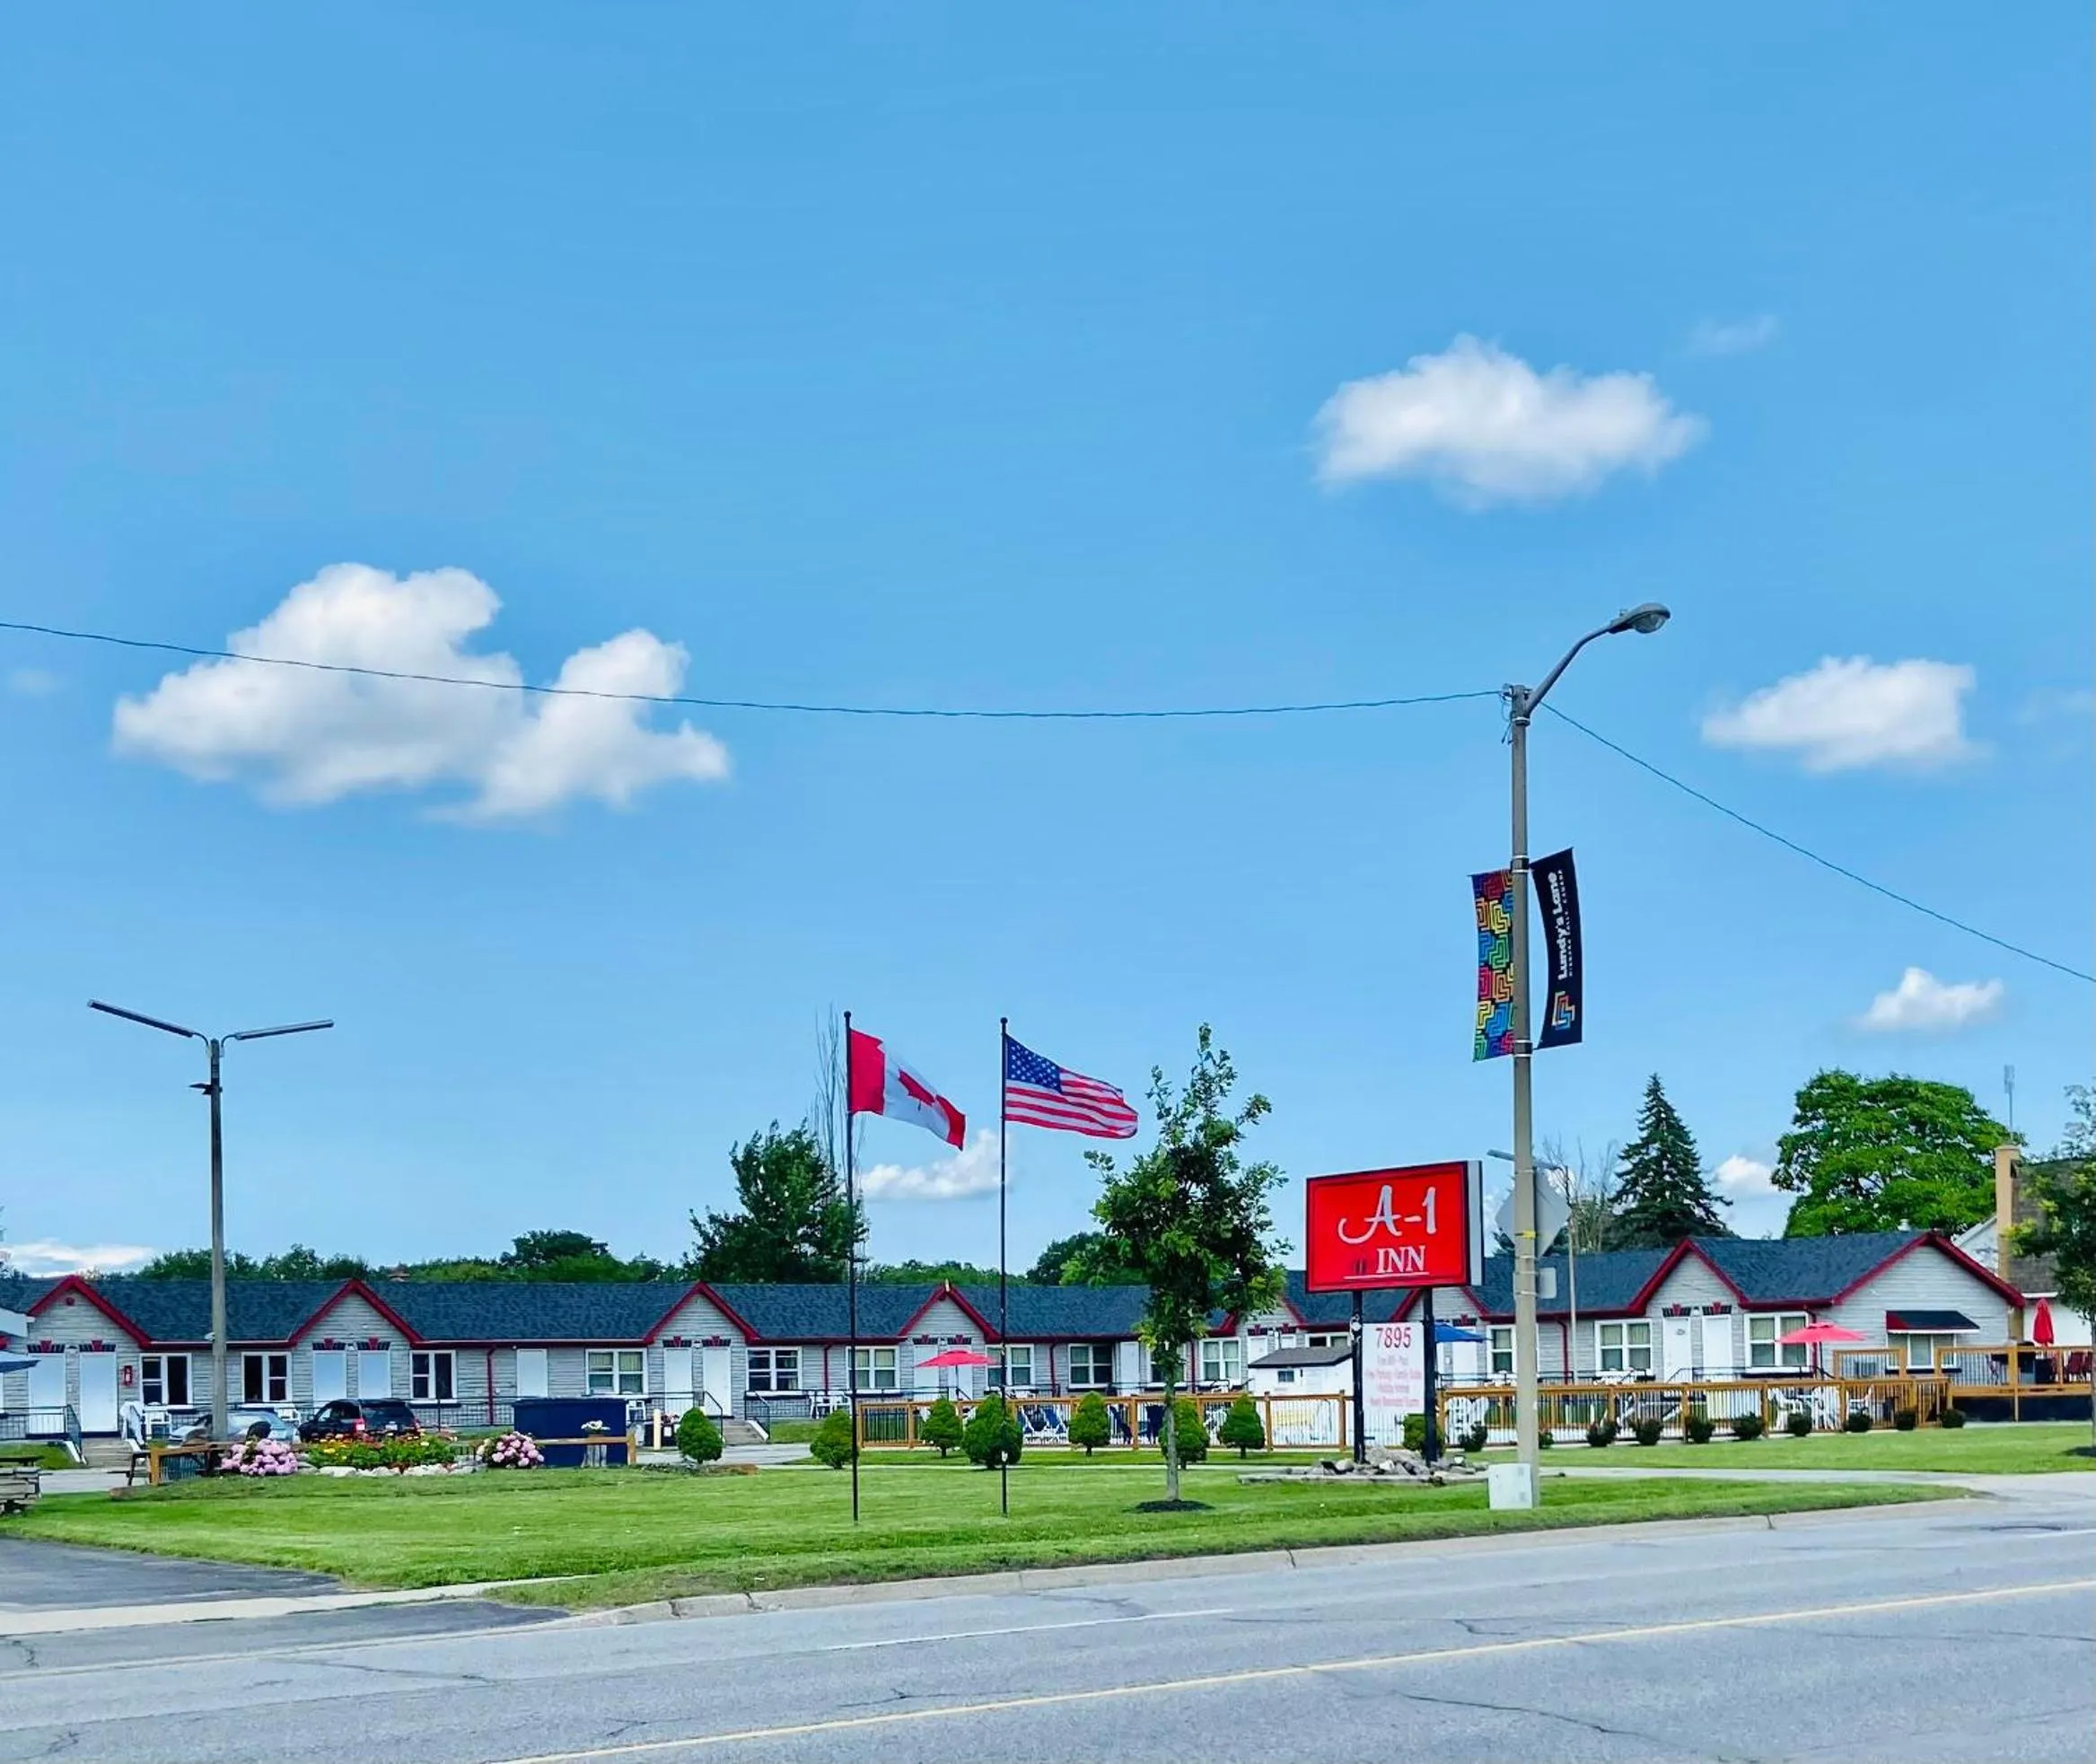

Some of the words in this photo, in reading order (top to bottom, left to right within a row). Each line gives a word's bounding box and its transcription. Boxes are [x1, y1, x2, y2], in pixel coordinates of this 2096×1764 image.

[1548, 872, 1563, 915] Lane
[1555, 917, 1570, 980] Lundy's
[1337, 1184, 1436, 1244] A-1
[1375, 1245, 1426, 1274] INN
[1375, 1327, 1412, 1348] 7895
